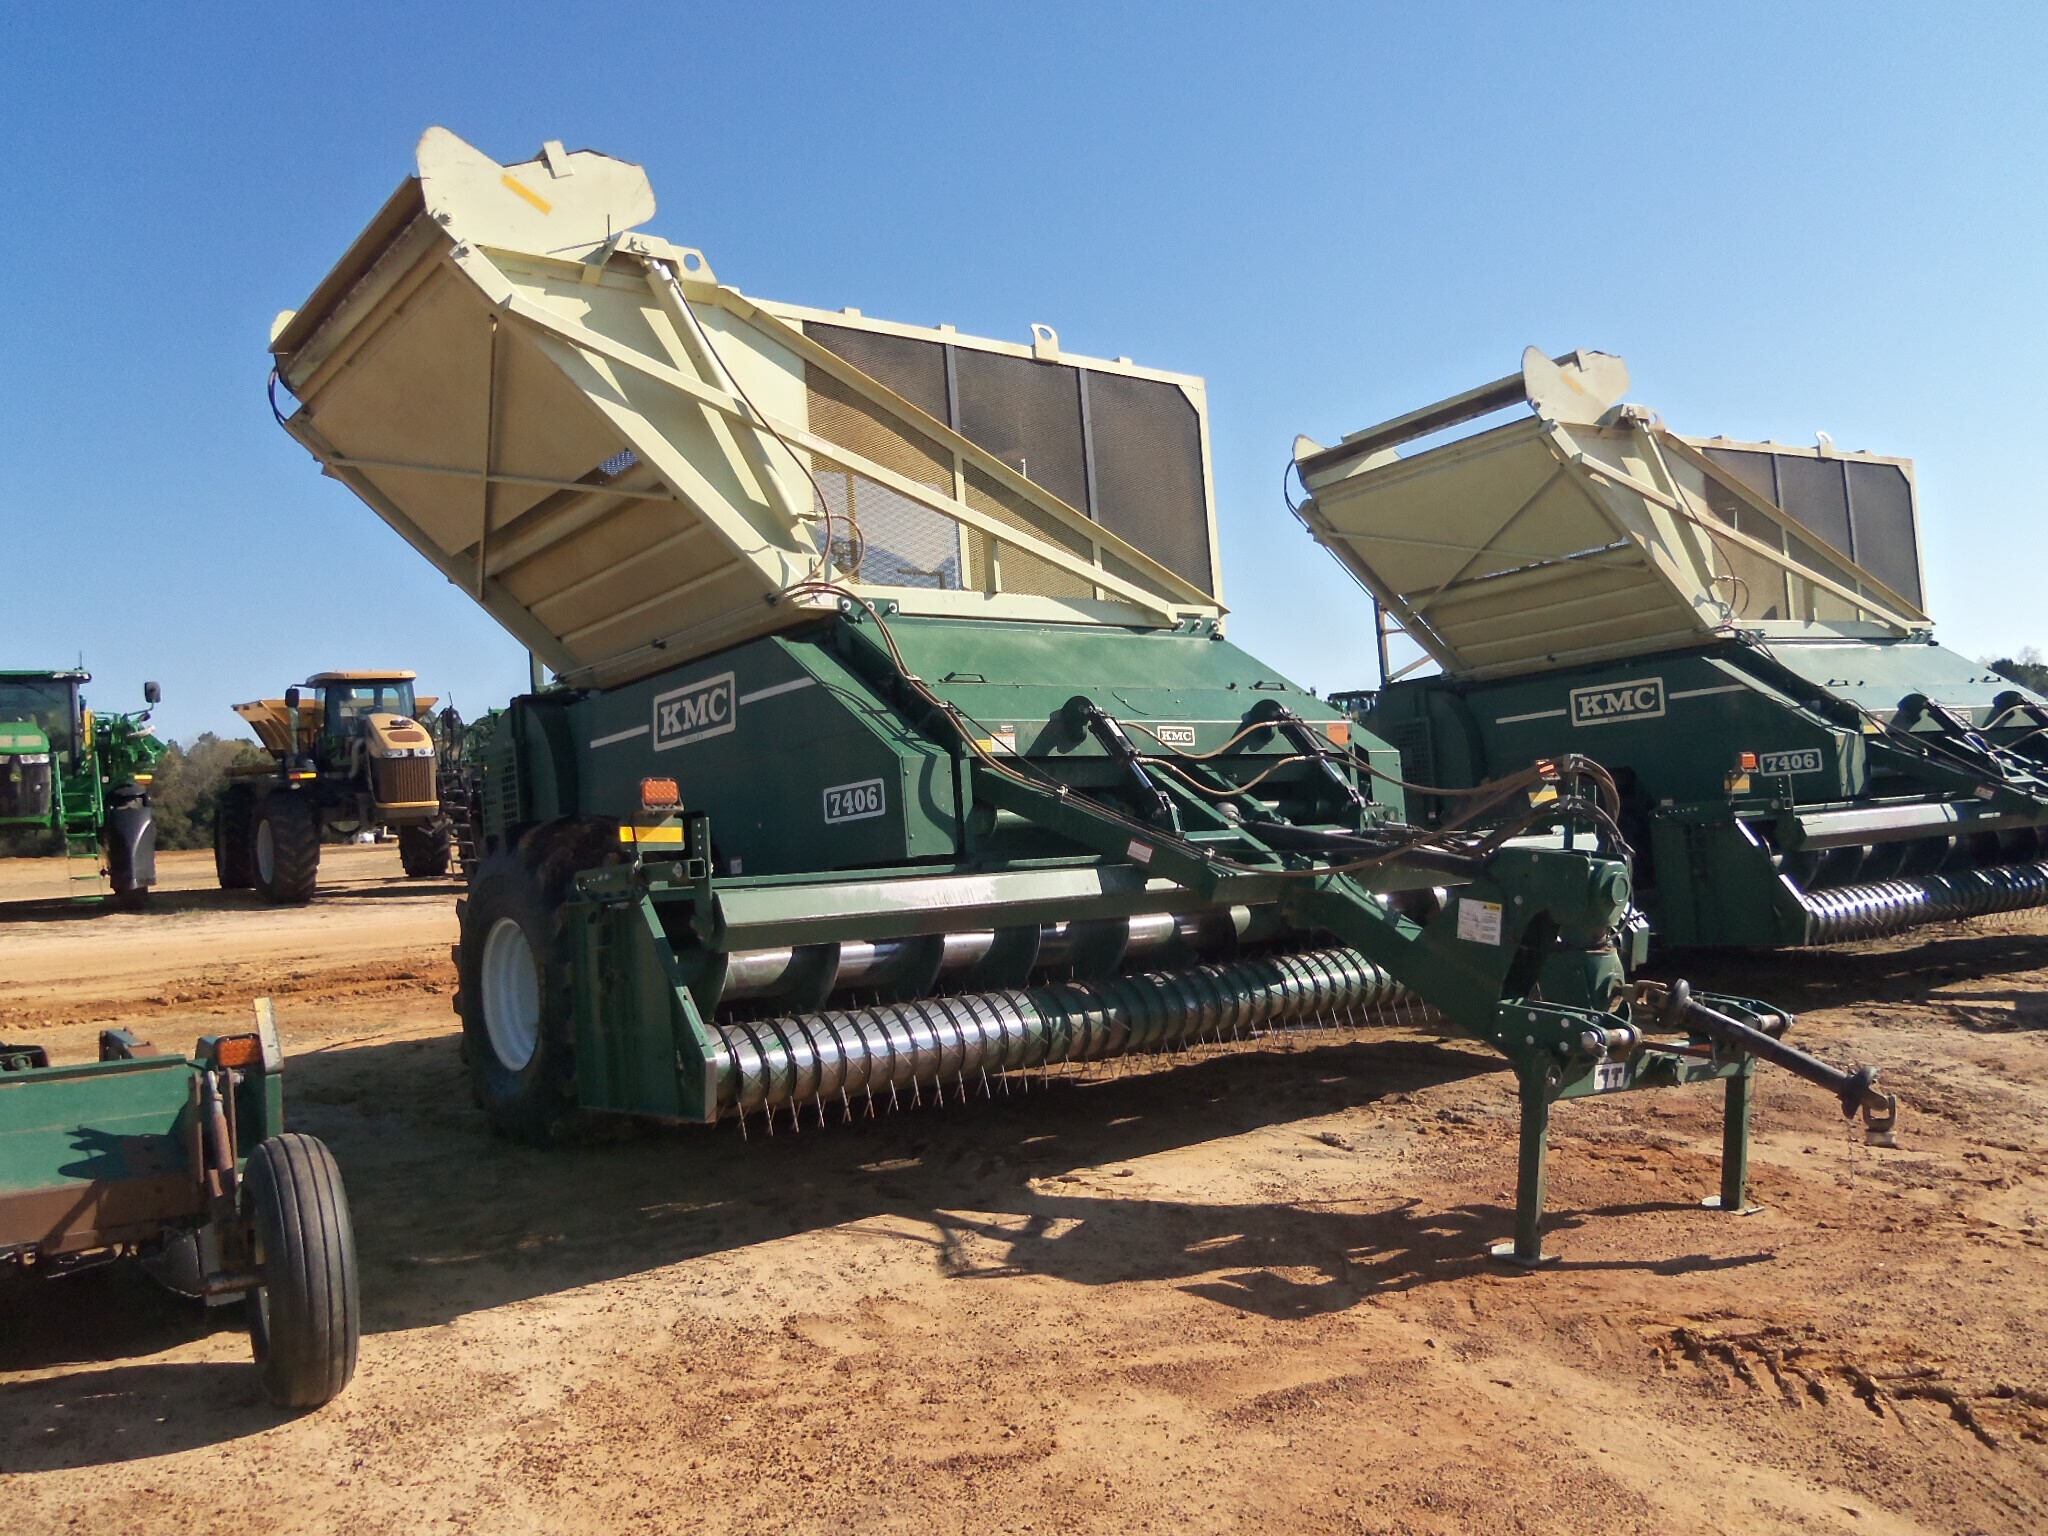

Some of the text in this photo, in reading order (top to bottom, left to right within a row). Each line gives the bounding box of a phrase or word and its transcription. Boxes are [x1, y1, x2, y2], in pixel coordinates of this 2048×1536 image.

[661, 687, 727, 736] KMC
[1579, 687, 1655, 717] KMC
[1161, 731, 1191, 741] KMC
[1767, 753, 1815, 771] 7406
[831, 786, 877, 816] 7406
